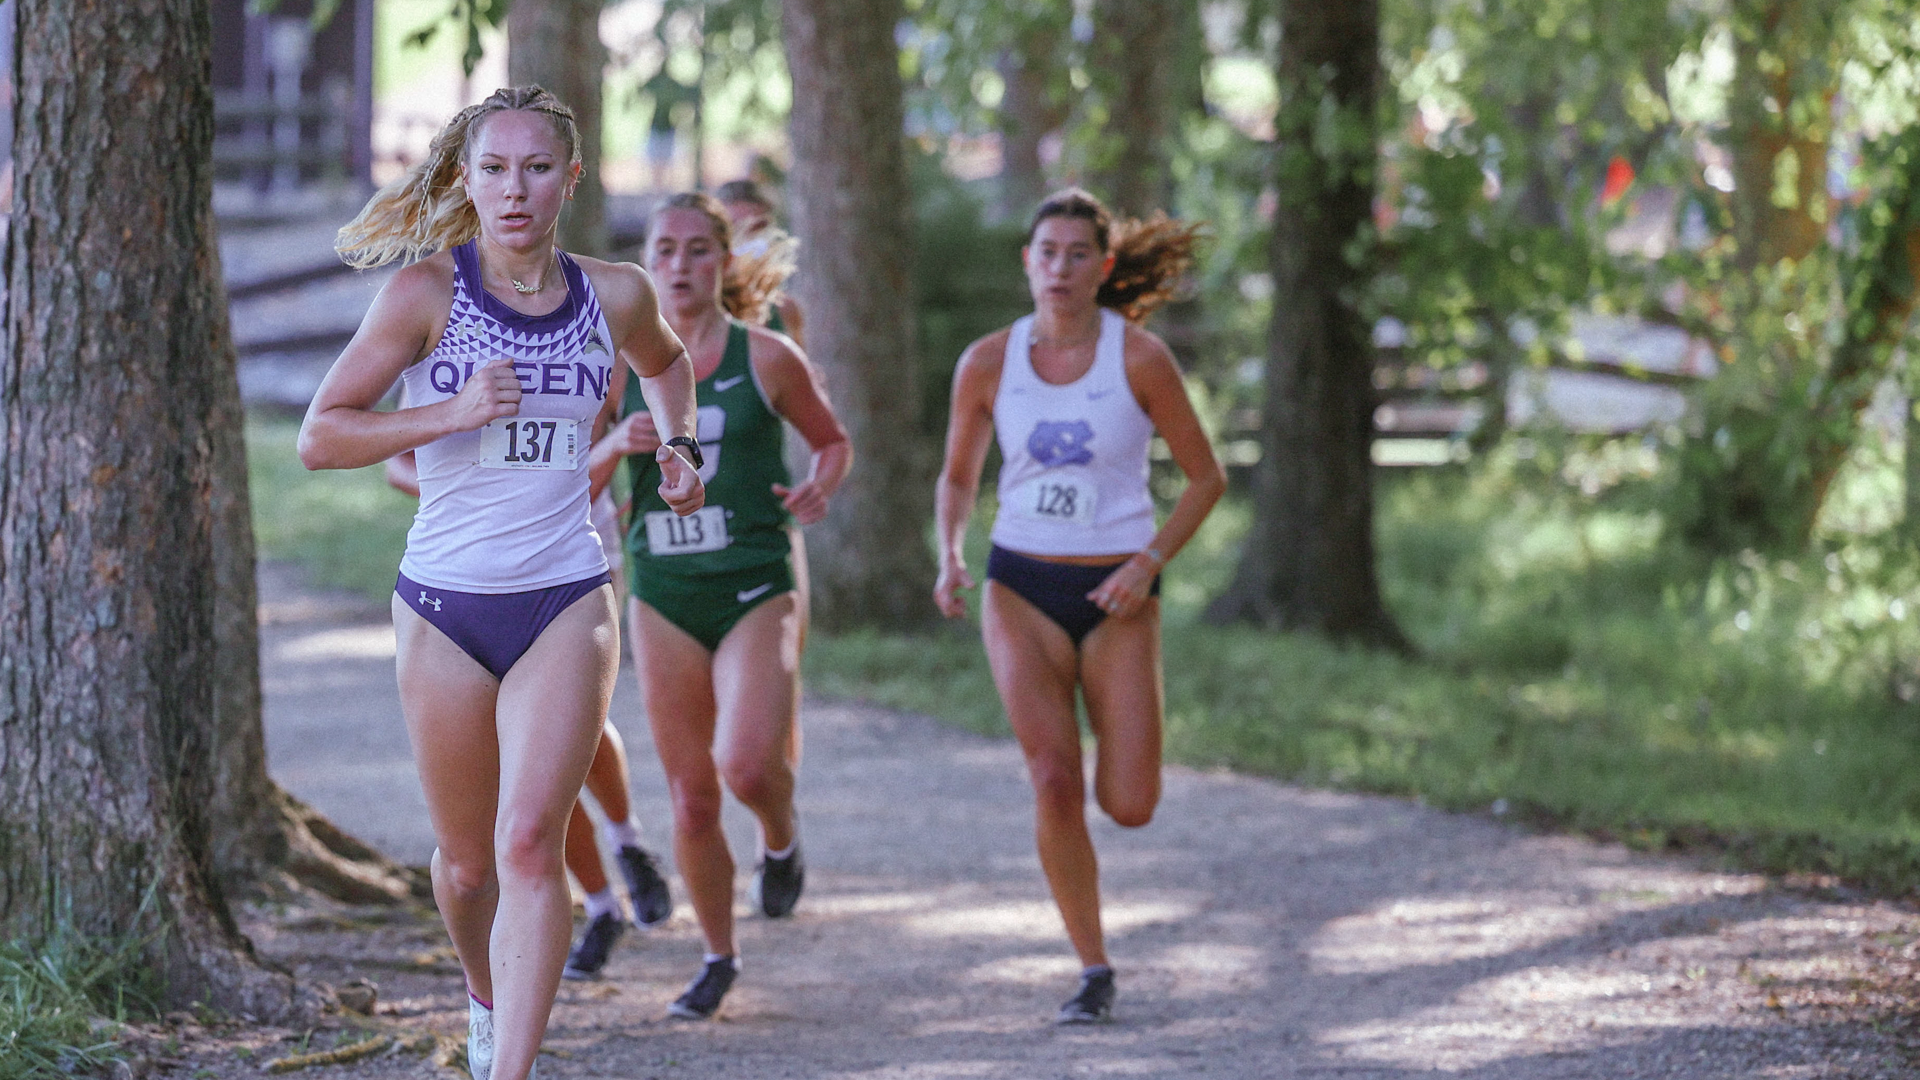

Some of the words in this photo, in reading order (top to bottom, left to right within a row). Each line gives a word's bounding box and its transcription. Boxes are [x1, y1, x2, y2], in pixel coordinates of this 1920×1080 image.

[430, 361, 612, 400] QEEN
[504, 421, 557, 462] 137
[1036, 484, 1078, 517] 128
[667, 514, 704, 545] 113
